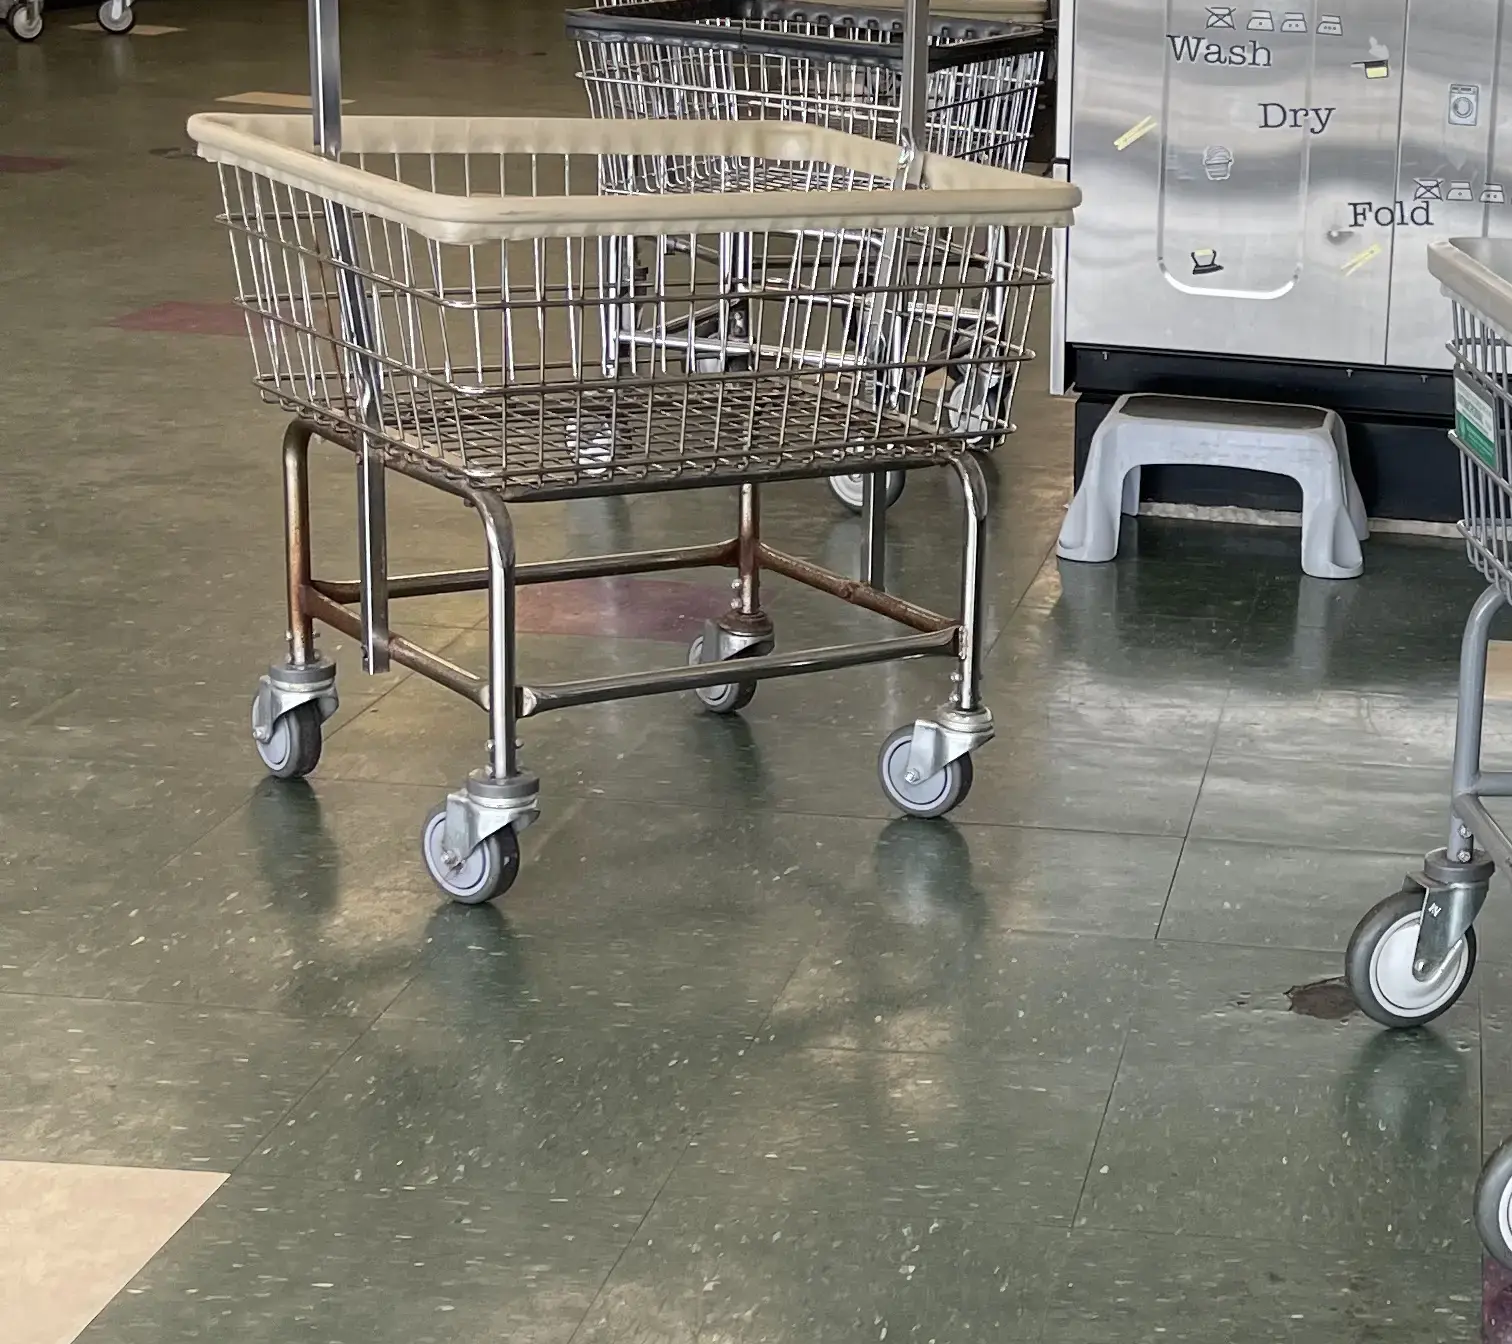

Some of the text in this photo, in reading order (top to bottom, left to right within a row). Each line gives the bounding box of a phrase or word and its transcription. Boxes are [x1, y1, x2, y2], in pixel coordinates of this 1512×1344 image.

[1167, 35, 1272, 67] Wash
[1259, 102, 1336, 135] Dry
[1348, 200, 1435, 228] Fold
